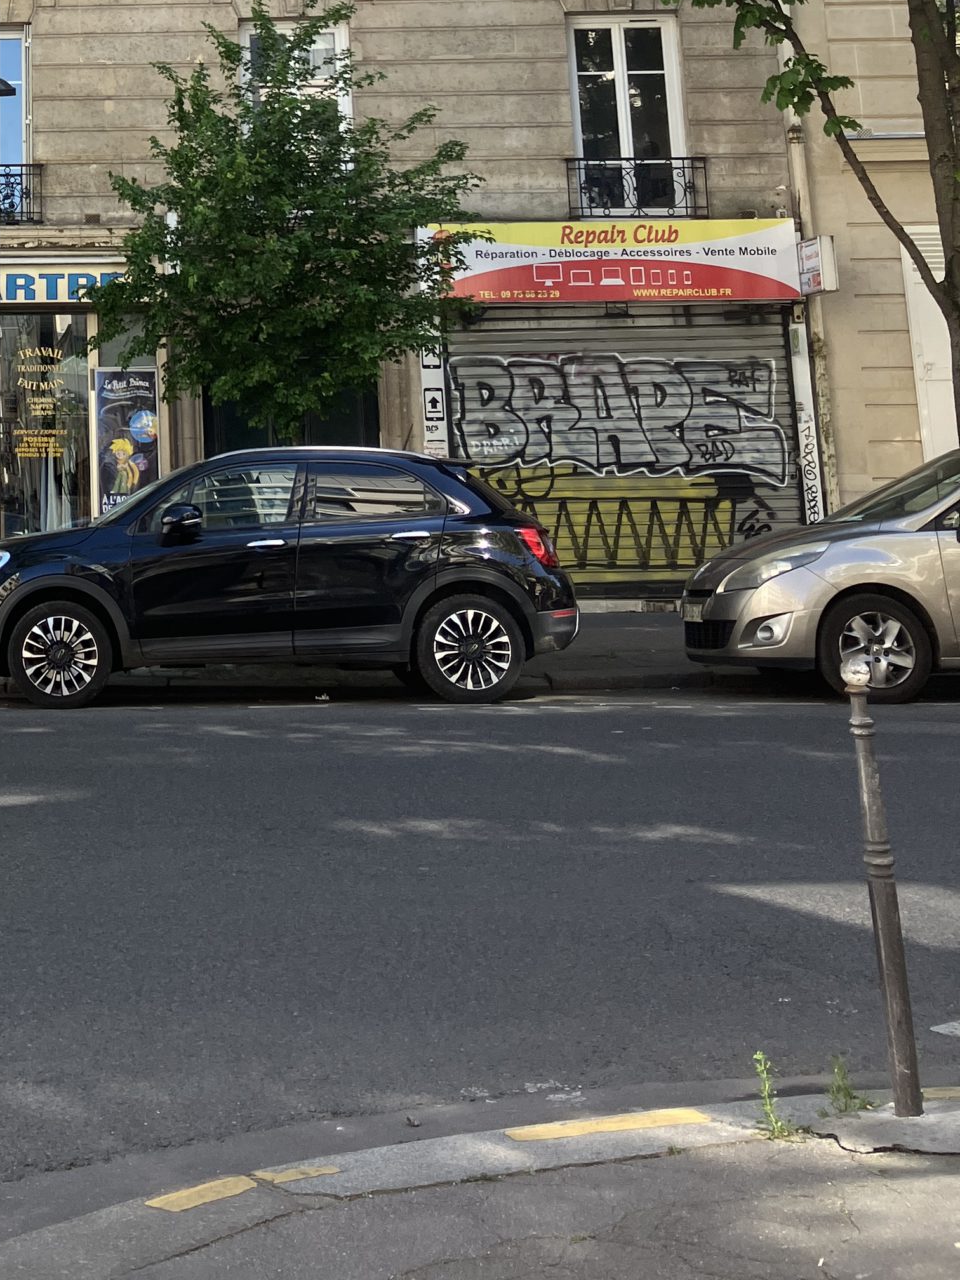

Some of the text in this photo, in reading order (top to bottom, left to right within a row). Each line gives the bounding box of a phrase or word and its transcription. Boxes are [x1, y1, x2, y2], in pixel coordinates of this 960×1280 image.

[560, 224, 679, 248] Repair Club
[475, 249, 538, 261] Réparation
[548, 248, 610, 260] Déblocage
[620, 248, 692, 258] Accessoires
[702, 247, 735, 257] Vente
[738, 246, 777, 257] Mobile
[633, 288, 732, 297] WWW.REPAIRCLUB.FR
[18, 347, 64, 360] TRAVAIL
[17, 378, 64, 390] FAIT MAIN
[696, 440, 736, 463] BAD
